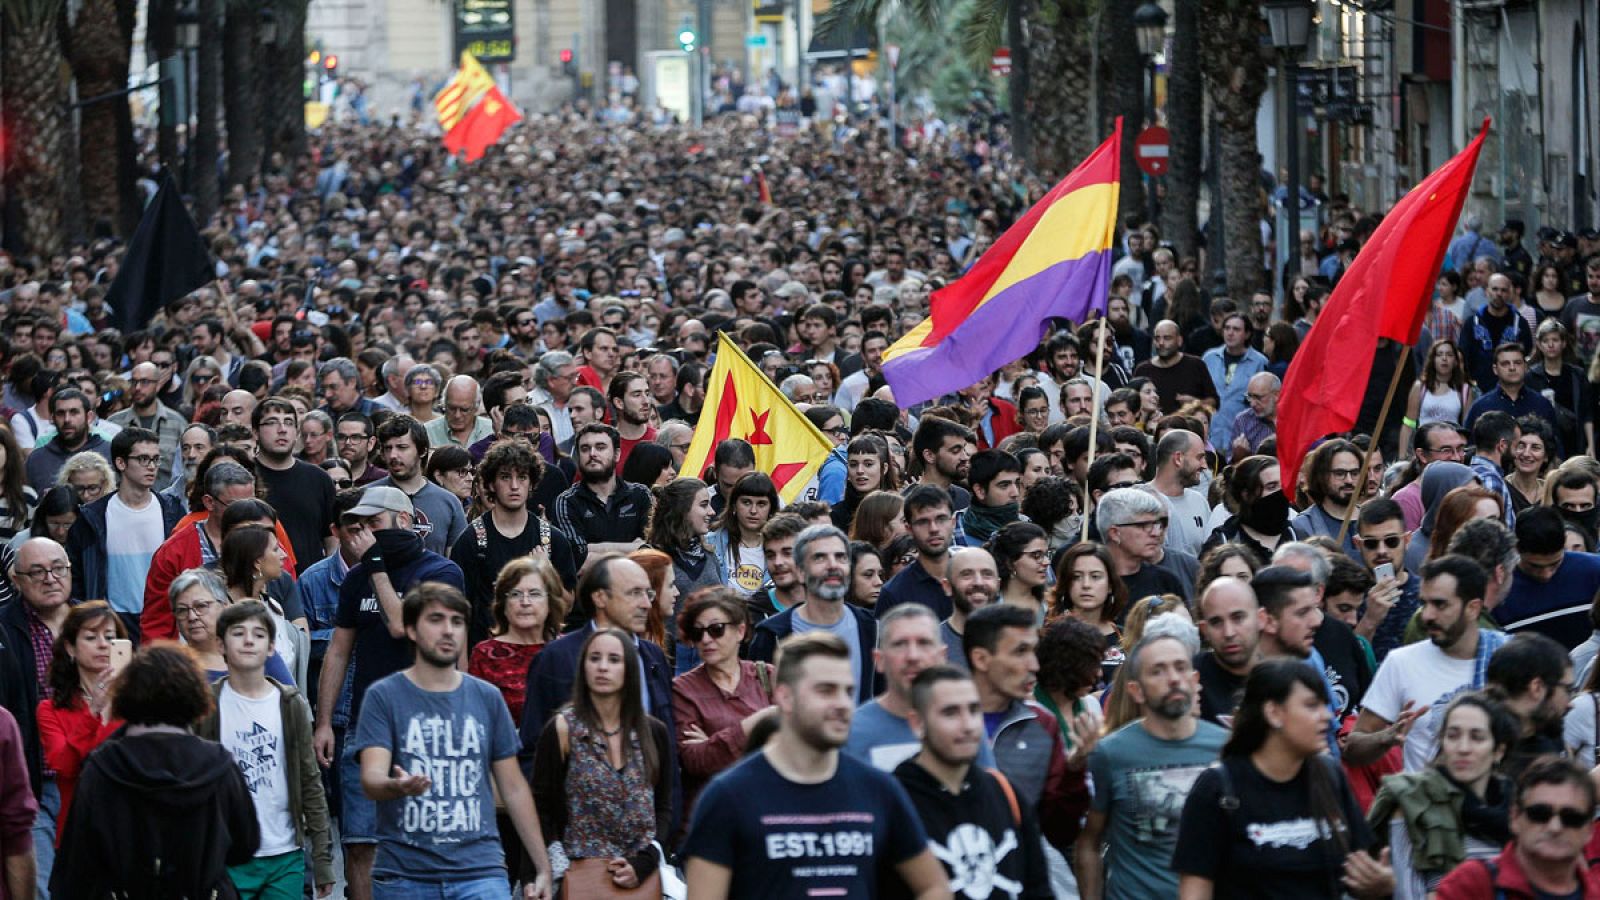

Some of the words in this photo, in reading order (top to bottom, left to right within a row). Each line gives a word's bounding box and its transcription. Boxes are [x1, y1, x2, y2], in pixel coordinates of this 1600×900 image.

[405, 716, 481, 757] ATLA
[403, 799, 481, 833] OCEAN
[765, 830, 874, 860] EST.1991
